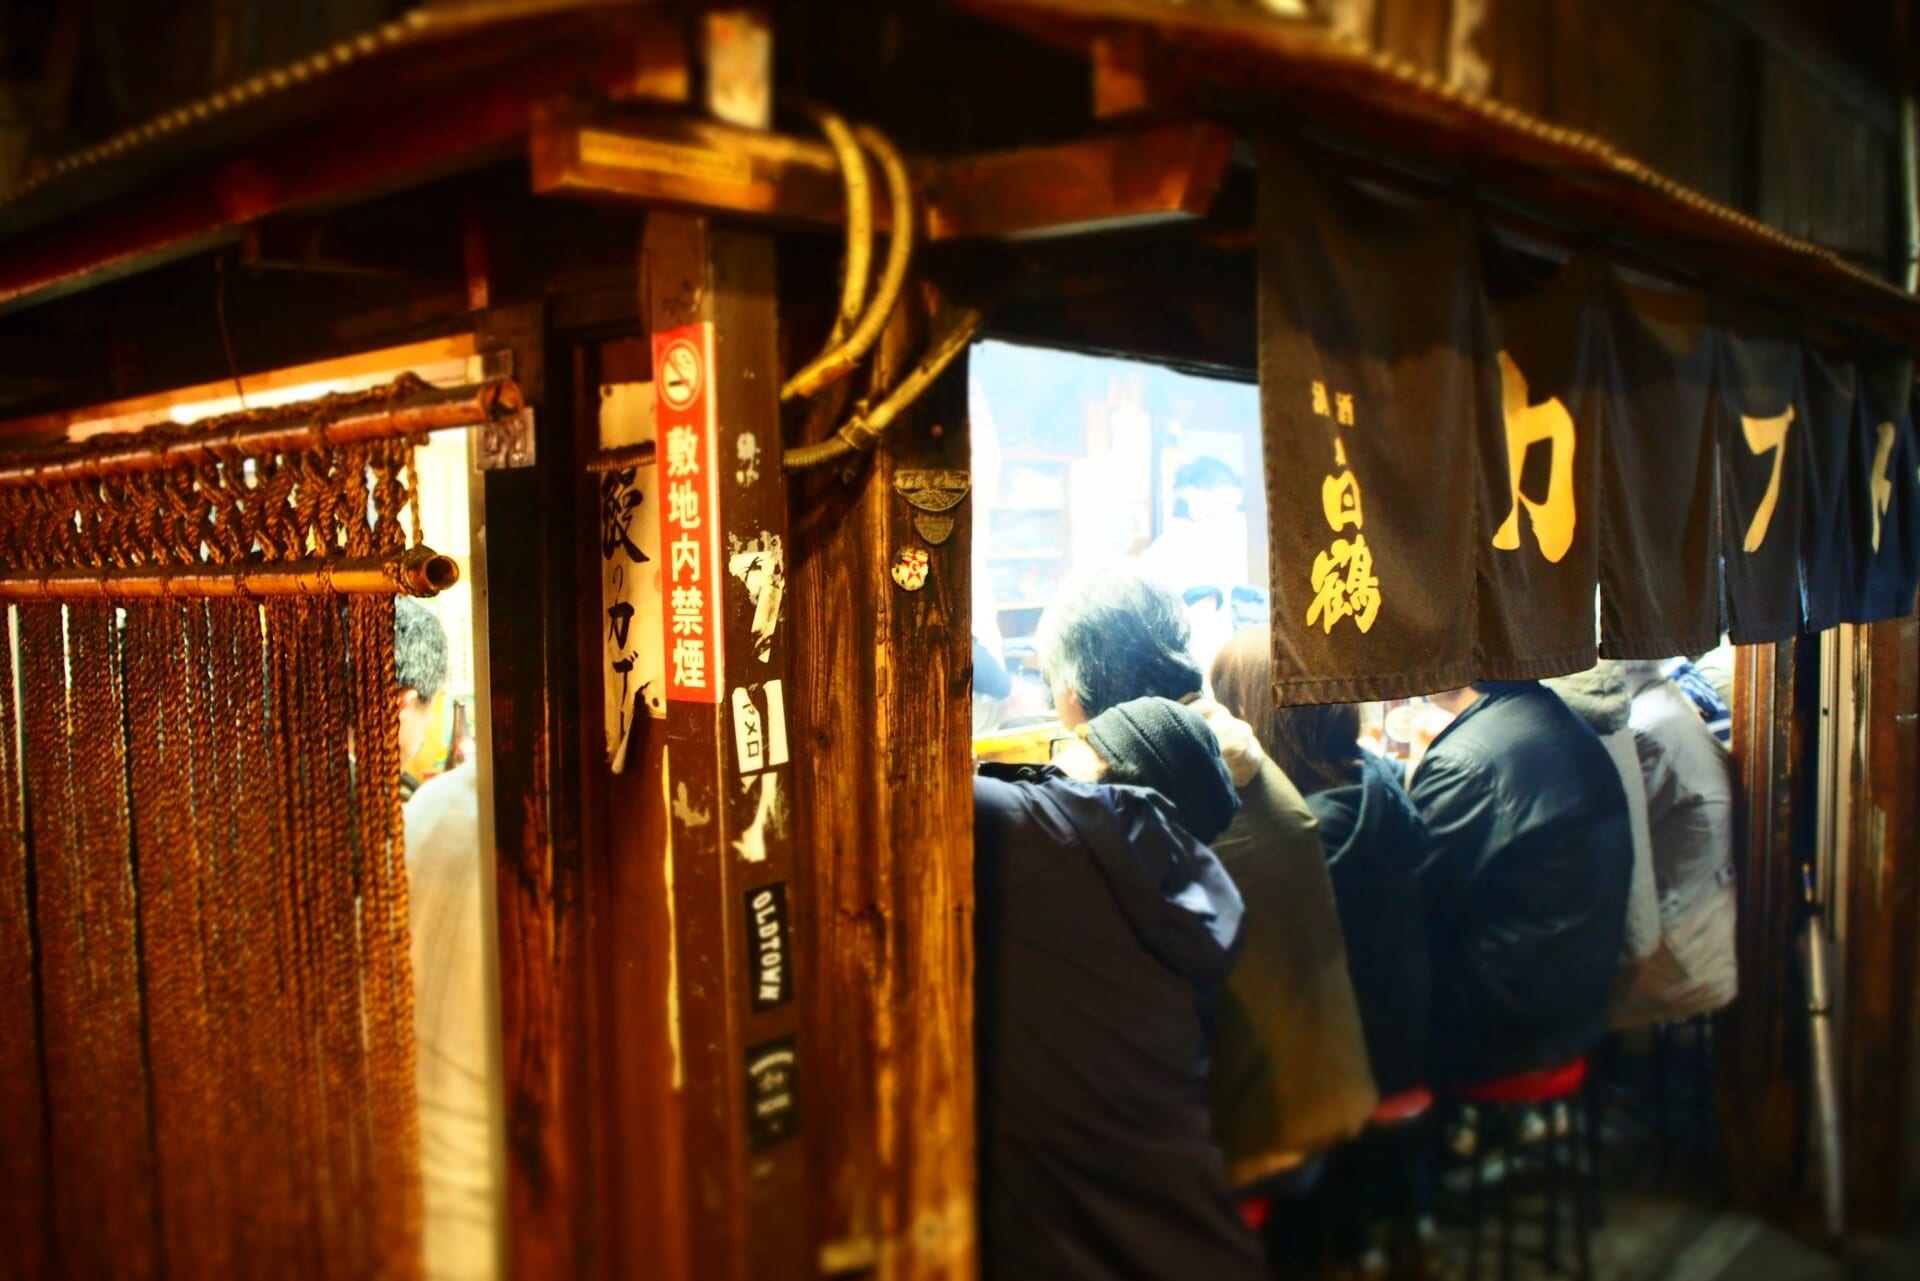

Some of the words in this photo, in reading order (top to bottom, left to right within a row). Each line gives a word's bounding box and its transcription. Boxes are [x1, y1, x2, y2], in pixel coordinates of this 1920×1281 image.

[665, 425, 706, 688] 敷地内禁煙
[752, 890, 782, 1001] OLDTOWN
